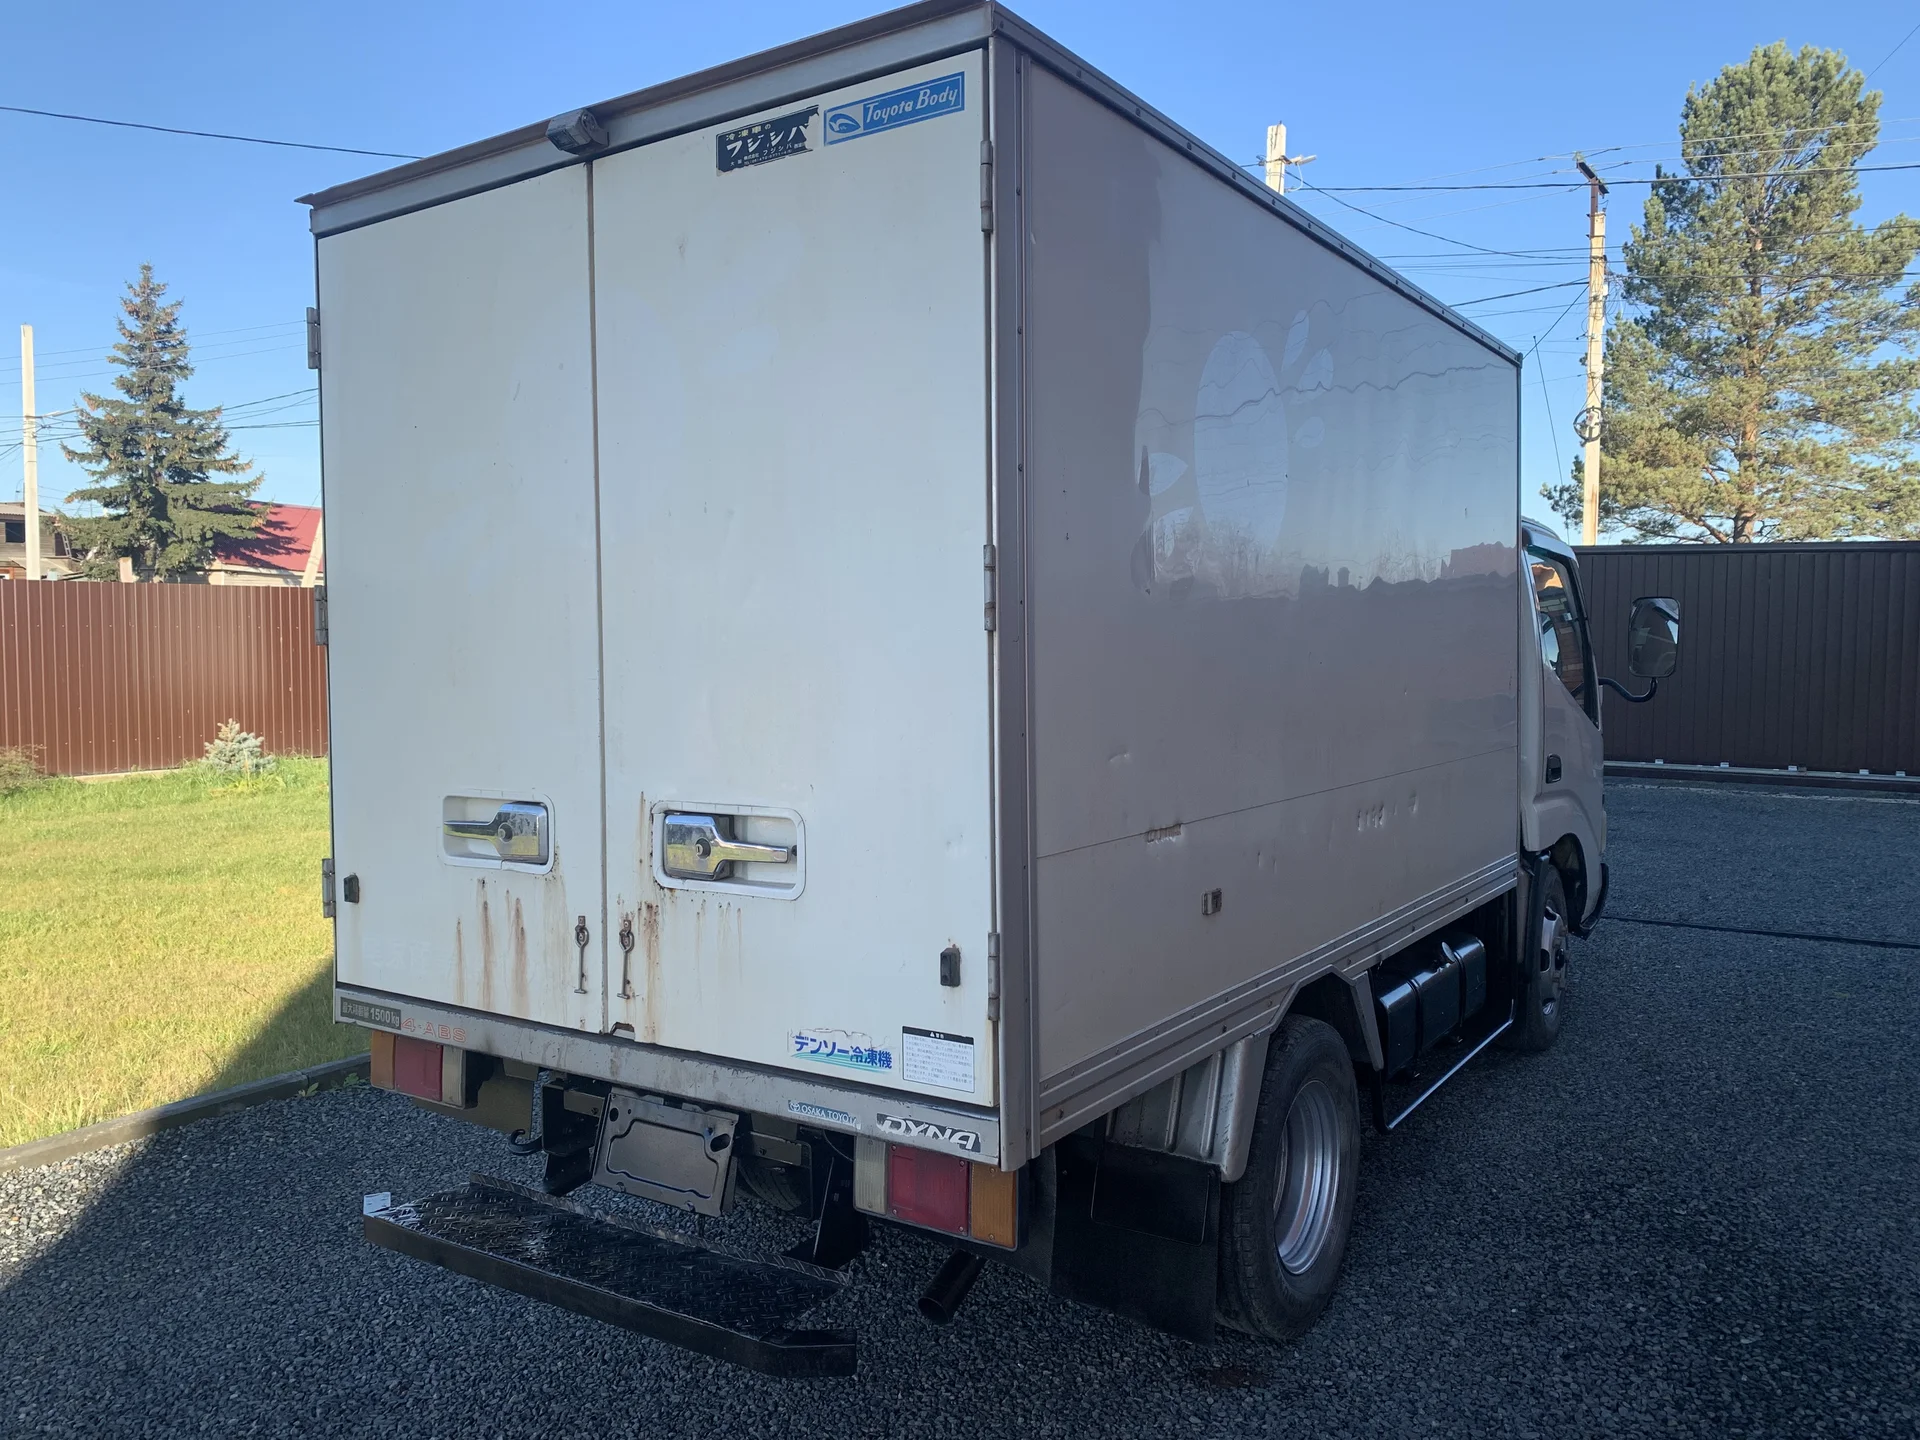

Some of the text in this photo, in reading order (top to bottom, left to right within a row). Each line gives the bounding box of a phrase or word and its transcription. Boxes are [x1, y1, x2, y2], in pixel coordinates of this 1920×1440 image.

[866, 86, 958, 124] Toyota Body
[370, 1006, 400, 1028] 1500kg
[794, 1035, 893, 1070] デンソー冷凍機
[801, 1104, 827, 1118] OSAKA
[880, 1116, 977, 1150] DYNA
